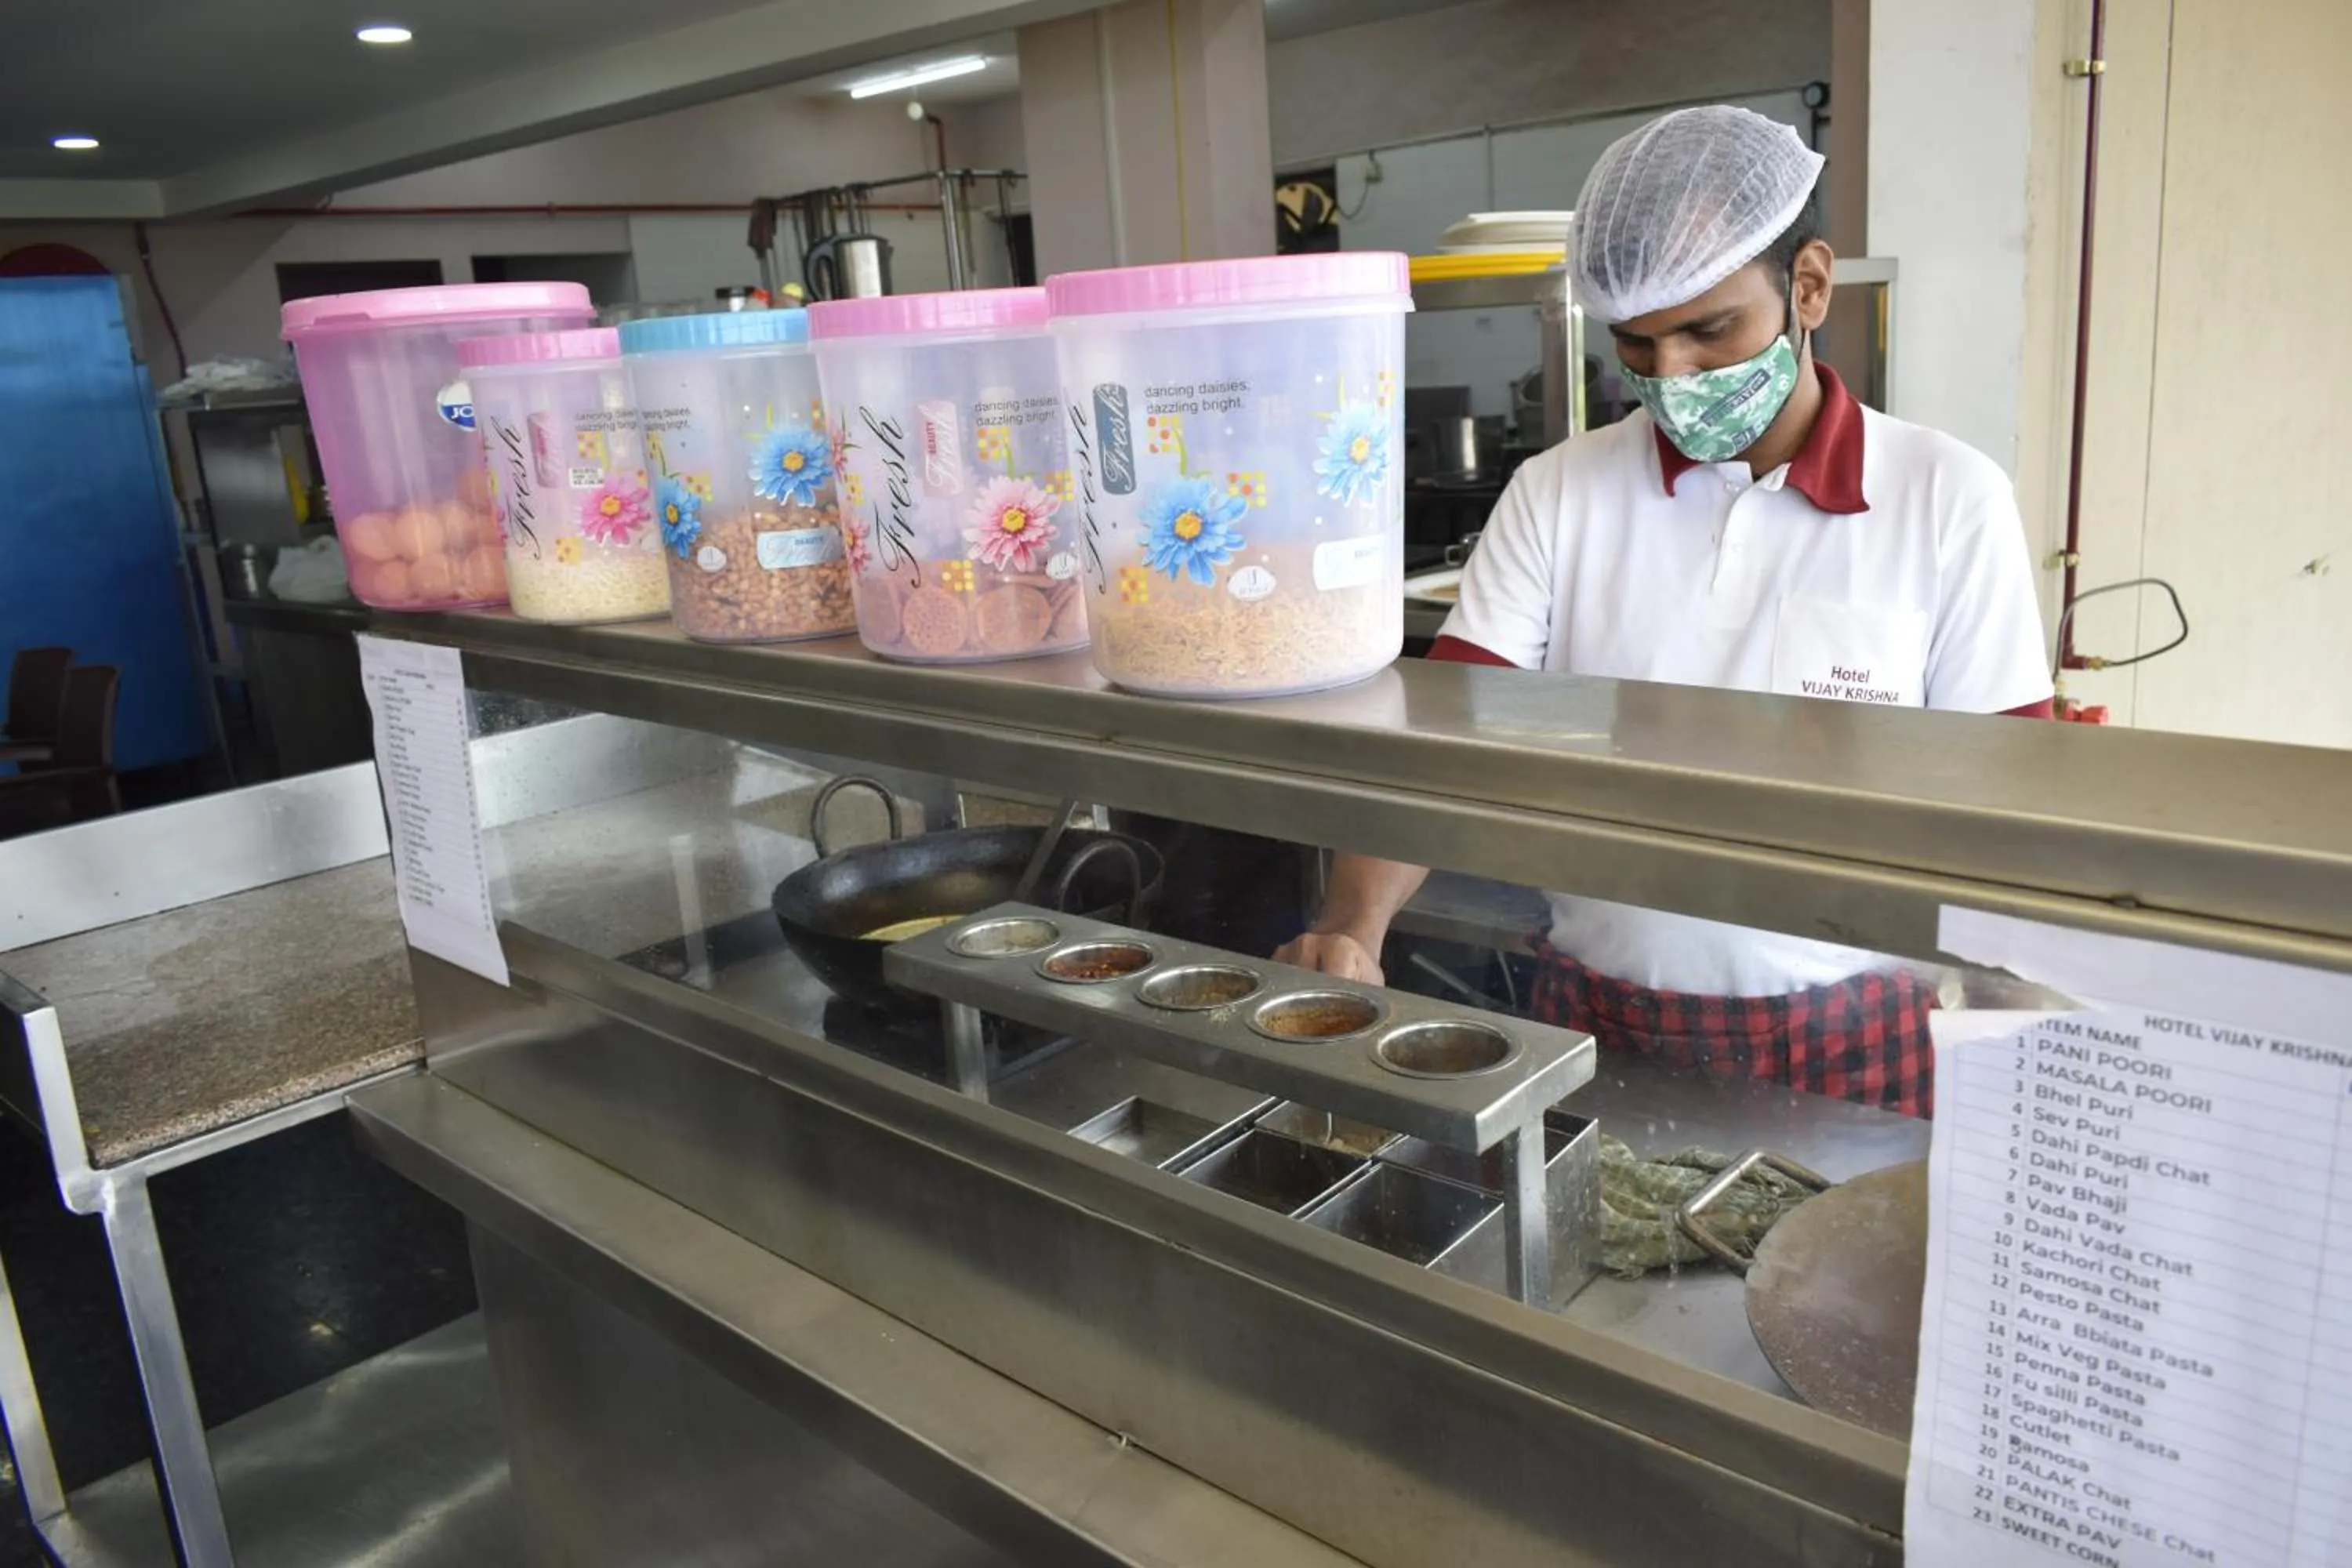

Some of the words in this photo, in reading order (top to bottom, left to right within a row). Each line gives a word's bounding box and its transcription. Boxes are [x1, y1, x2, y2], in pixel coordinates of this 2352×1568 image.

[974, 401, 1020, 412] dancing
[976, 413, 1024, 427] dazzling
[1144, 385, 1194, 398] dancing
[1146, 401, 1199, 415] dazzling
[491, 416, 542, 561] Fresh
[859, 405, 921, 589] Fresh
[1802, 680, 1842, 697] VIJAY
[1845, 687, 1900, 703] KRISHNA
[1831, 666, 1871, 684] Hotel
[2016, 1036, 2025, 1049] 1
[2038, 1038, 2091, 1063] PANI
[2097, 1051, 2172, 1080] POORI
[2087, 1026, 2143, 1051] NAME
[2144, 1015, 2205, 1040] HOTEL
[2210, 1028, 2265, 1051] VIJAY
[2015, 1080, 2024, 1094] 3
[2034, 1083, 2082, 1108] Bhel
[2088, 1096, 2134, 1120] Puri
[2016, 1057, 2025, 1070] 2
[2037, 1061, 2129, 1096] MASALA
[2135, 1083, 2212, 1114] POORI
[2012, 1102, 2022, 1115] 4
[2033, 1107, 2069, 1127] Sev
[2076, 1117, 2121, 1140] Puri
[2009, 1146, 2019, 1160] 6
[2030, 1152, 2078, 1177] Dahi
[2084, 1166, 2129, 1189] Puri
[2011, 1124, 2020, 1138] 5
[2032, 1128, 2078, 1154] Dahi
[2085, 1143, 2150, 1173] Papdi
[2156, 1160, 2211, 1187] Chat
[2005, 1191, 2016, 1204] 8
[2026, 1196, 2079, 1222] Vada
[2085, 1212, 2126, 1235] Pav
[2008, 1168, 2017, 1181] 7
[2027, 1174, 2066, 1196] Pav
[2071, 1185, 2128, 1215] Bhaji
[1994, 1231, 2013, 1247] 10
[2023, 1240, 2104, 1274] Kachori
[2109, 1265, 2161, 1292] Chat
[2004, 1212, 2014, 1225] 9
[2024, 1218, 2072, 1243] Dahi
[2079, 1232, 2133, 1261] Vada
[2140, 1251, 2194, 1276] Chat
[1991, 1272, 2009, 1290] 12
[2019, 1282, 2078, 1311] Pesto
[2085, 1301, 2145, 1332] Pasta
[1993, 1252, 2009, 1269] 11
[2020, 1261, 2103, 1297] Samosa
[2109, 1288, 2161, 1316] Chat
[1988, 1321, 2005, 1338] 14
[2016, 1331, 2051, 1353] Mix
[2058, 1342, 2100, 1370] Veg
[2106, 1358, 2167, 1390] Pasta
[1990, 1300, 2007, 1317] 13
[2017, 1308, 2062, 1331] Arra
[2074, 1323, 2143, 1358] Bbiata
[2150, 1346, 2215, 1378] Pasta
[1985, 1363, 2003, 1379] 16
[2013, 1373, 2038, 1392] Fu
[2044, 1383, 2078, 1405] silli
[2085, 1396, 2144, 1427] Pasta
[1987, 1342, 2004, 1359] 15
[2014, 1352, 2080, 1383] Penna
[2086, 1374, 2147, 1406] Pasta
[1980, 1424, 1998, 1440] 19
[1982, 1403, 2000, 1420] 18
[2009, 1414, 2071, 1446] Cutlet
[1984, 1383, 2002, 1399] 17
[2011, 1393, 2114, 1438] Spaghetti
[2119, 1429, 2181, 1462] Pasta
[1979, 1443, 1998, 1460] 20
[2007, 1453, 2077, 1490] PALAK
[2082, 1482, 2132, 1512] Chat
[1973, 1506, 1992, 1524] 23
[2002, 1515, 2062, 1549] SWEET
[2066, 1542, 2121, 1568] CORN
[1975, 1484, 1994, 1502] 22
[2004, 1495, 2071, 1532] EXTRA
[2077, 1523, 2123, 1550] PAV
[1977, 1464, 1995, 1481] 21
[2086, 1506, 2157, 1541] CHESE
[2164, 1534, 2216, 1564] Chat
